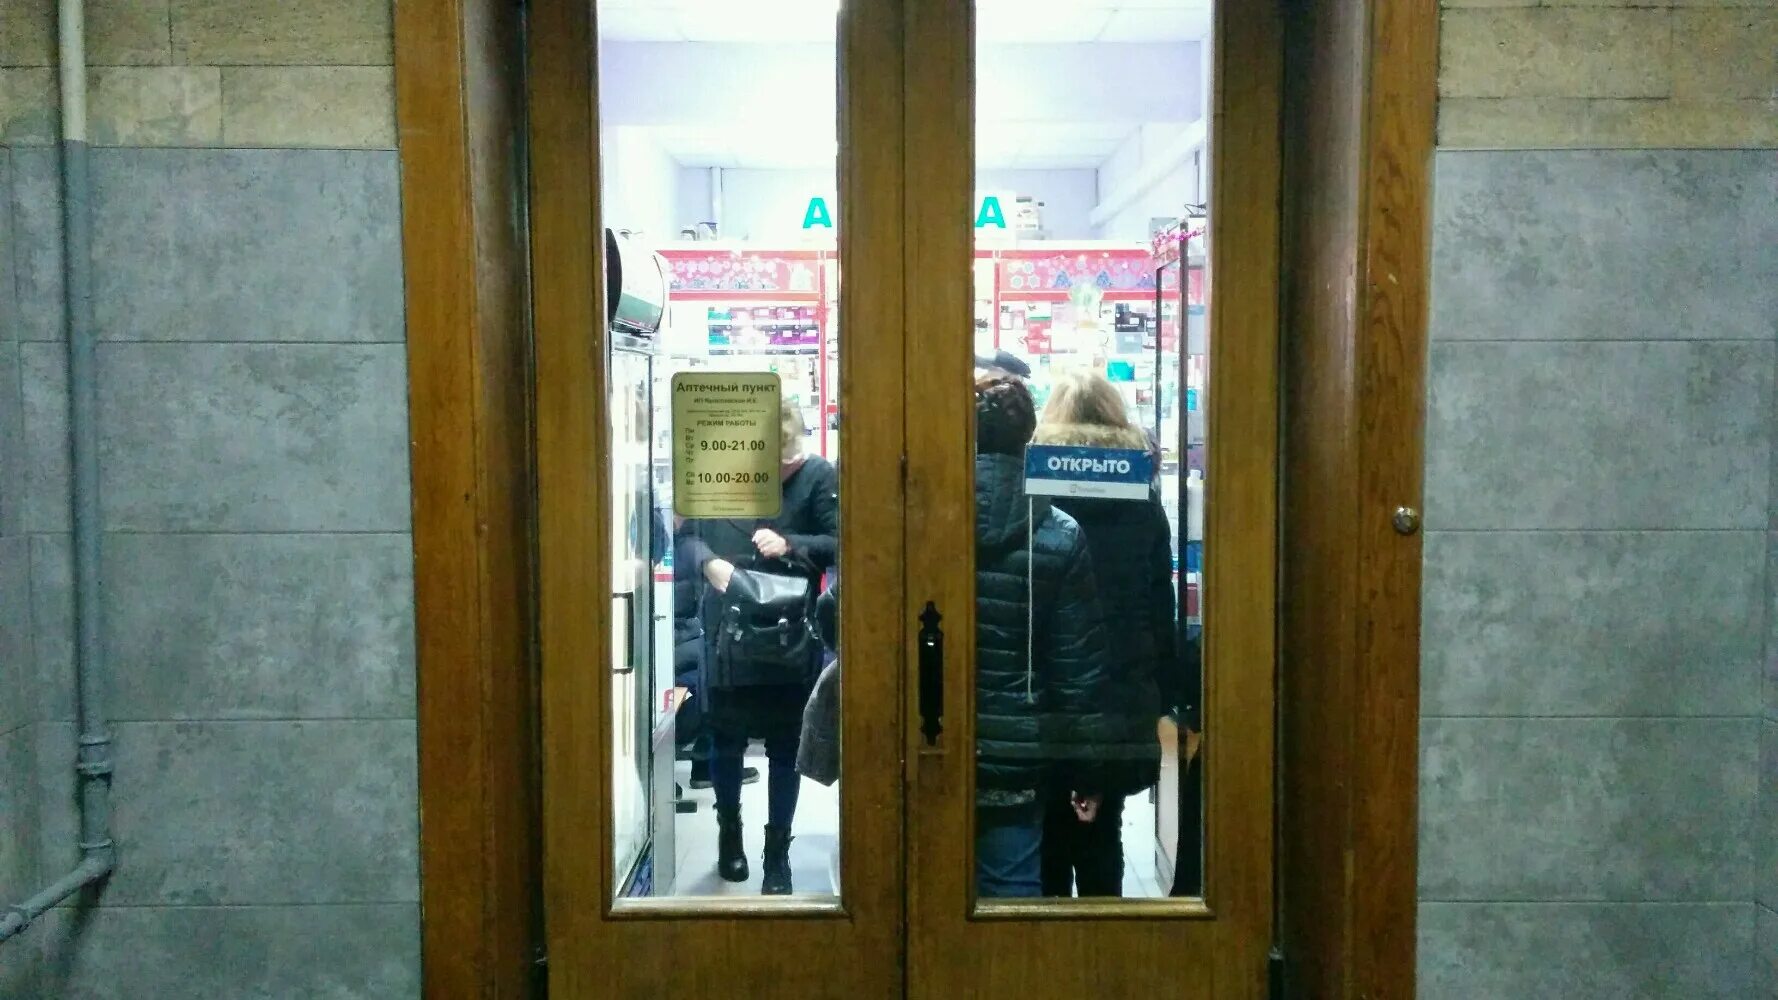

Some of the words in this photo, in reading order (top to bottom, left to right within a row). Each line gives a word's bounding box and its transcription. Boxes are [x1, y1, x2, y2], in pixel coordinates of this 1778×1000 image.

[676, 382, 739, 393] Аптечный
[742, 383, 777, 395] пункт
[700, 440, 765, 451] 9.00-21.00
[1047, 456, 1131, 475] ОТКРЫТО
[698, 472, 769, 483] 10.00-20.00
